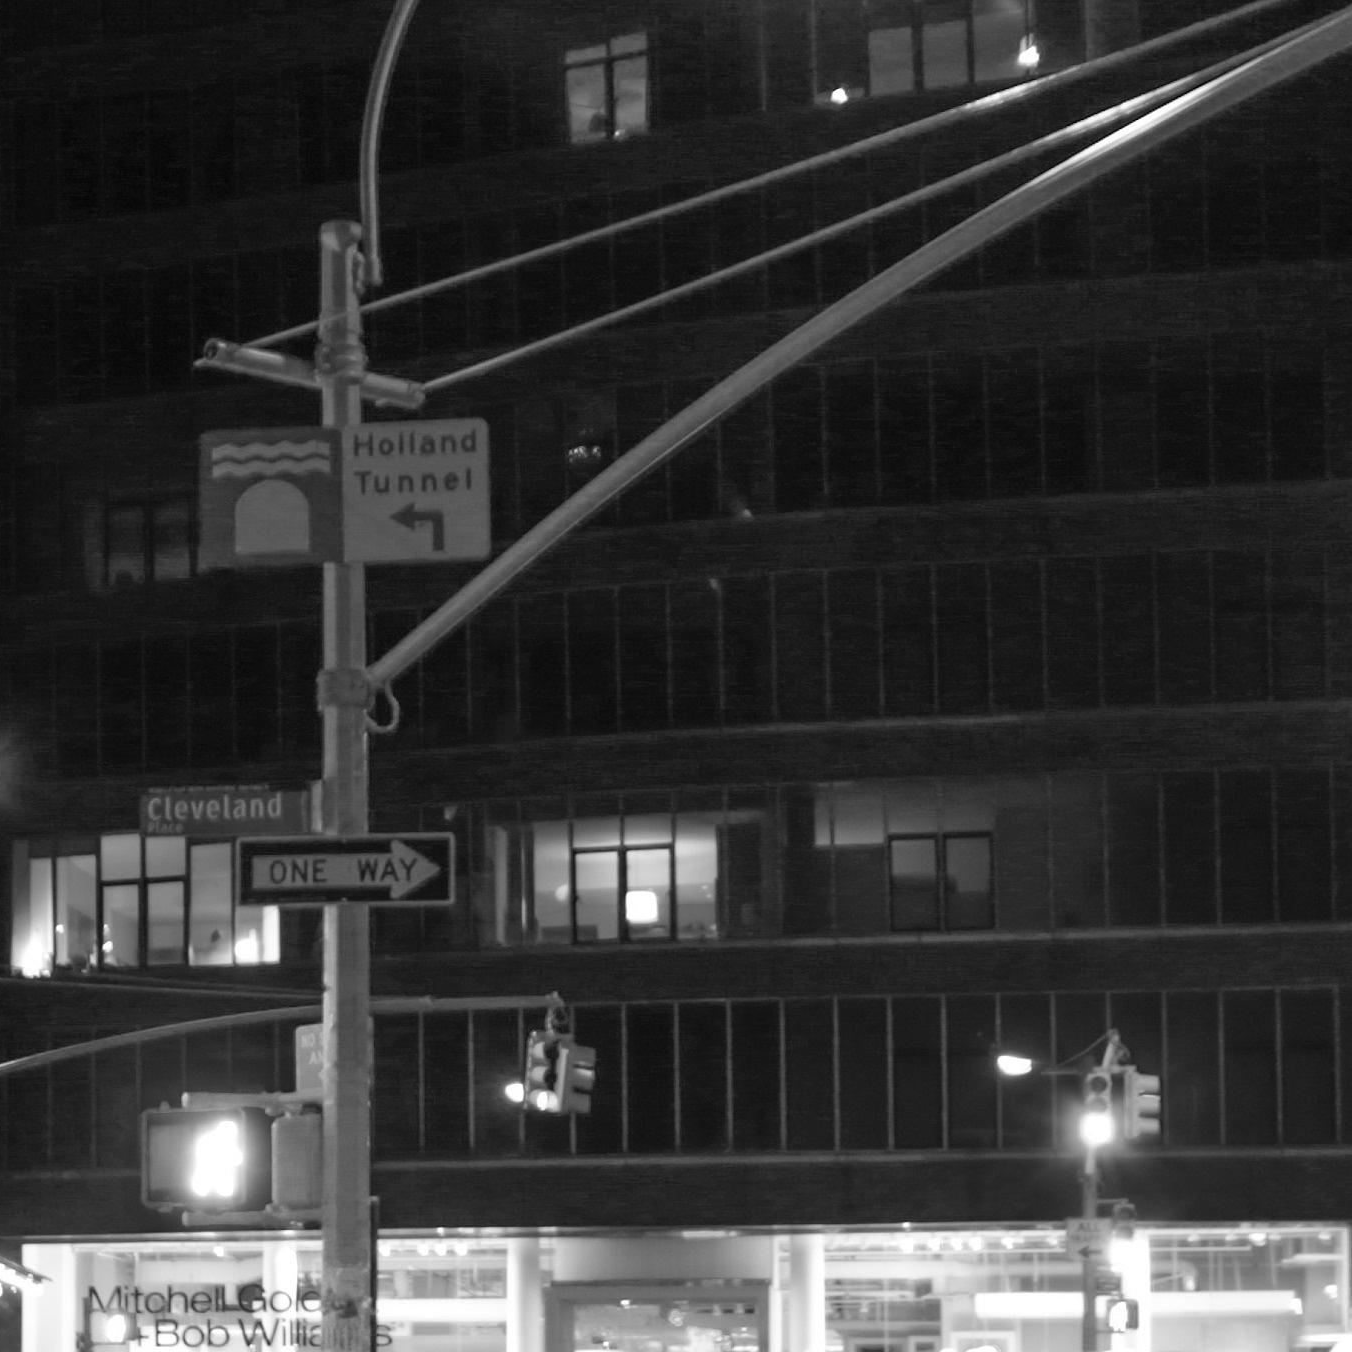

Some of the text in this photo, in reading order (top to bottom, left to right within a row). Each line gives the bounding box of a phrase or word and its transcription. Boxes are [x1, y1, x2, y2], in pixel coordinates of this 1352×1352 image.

[352, 430, 479, 458] Holland
[353, 468, 473, 495] Tunnel
[147, 790, 283, 821] Cleveland
[269, 856, 418, 884] ONE WAY
[87, 1283, 224, 1314] Mitchell
